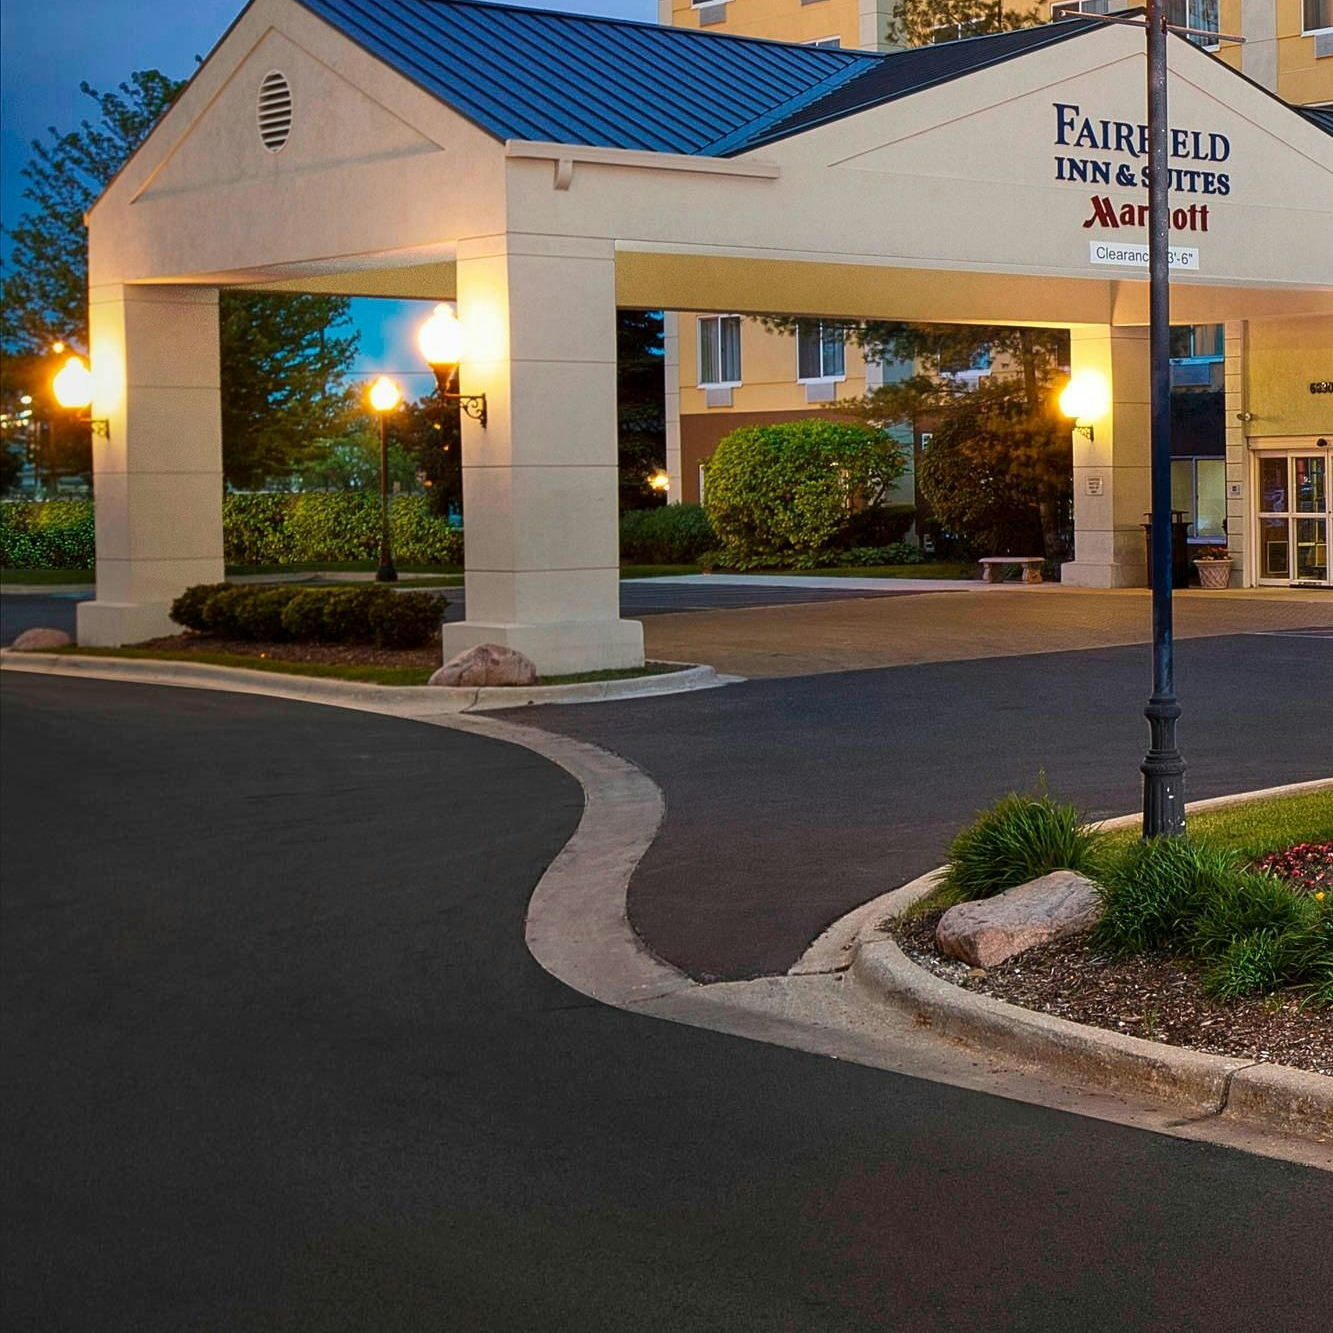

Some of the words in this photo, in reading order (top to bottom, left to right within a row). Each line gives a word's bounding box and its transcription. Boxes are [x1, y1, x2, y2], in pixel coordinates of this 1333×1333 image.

[1052, 103, 1231, 163] FAIRFELD
[1055, 156, 1112, 184] INN
[1116, 164, 1138, 187] &
[1082, 195, 1209, 232] Marott
[1096, 246, 1150, 263] Clearanc
